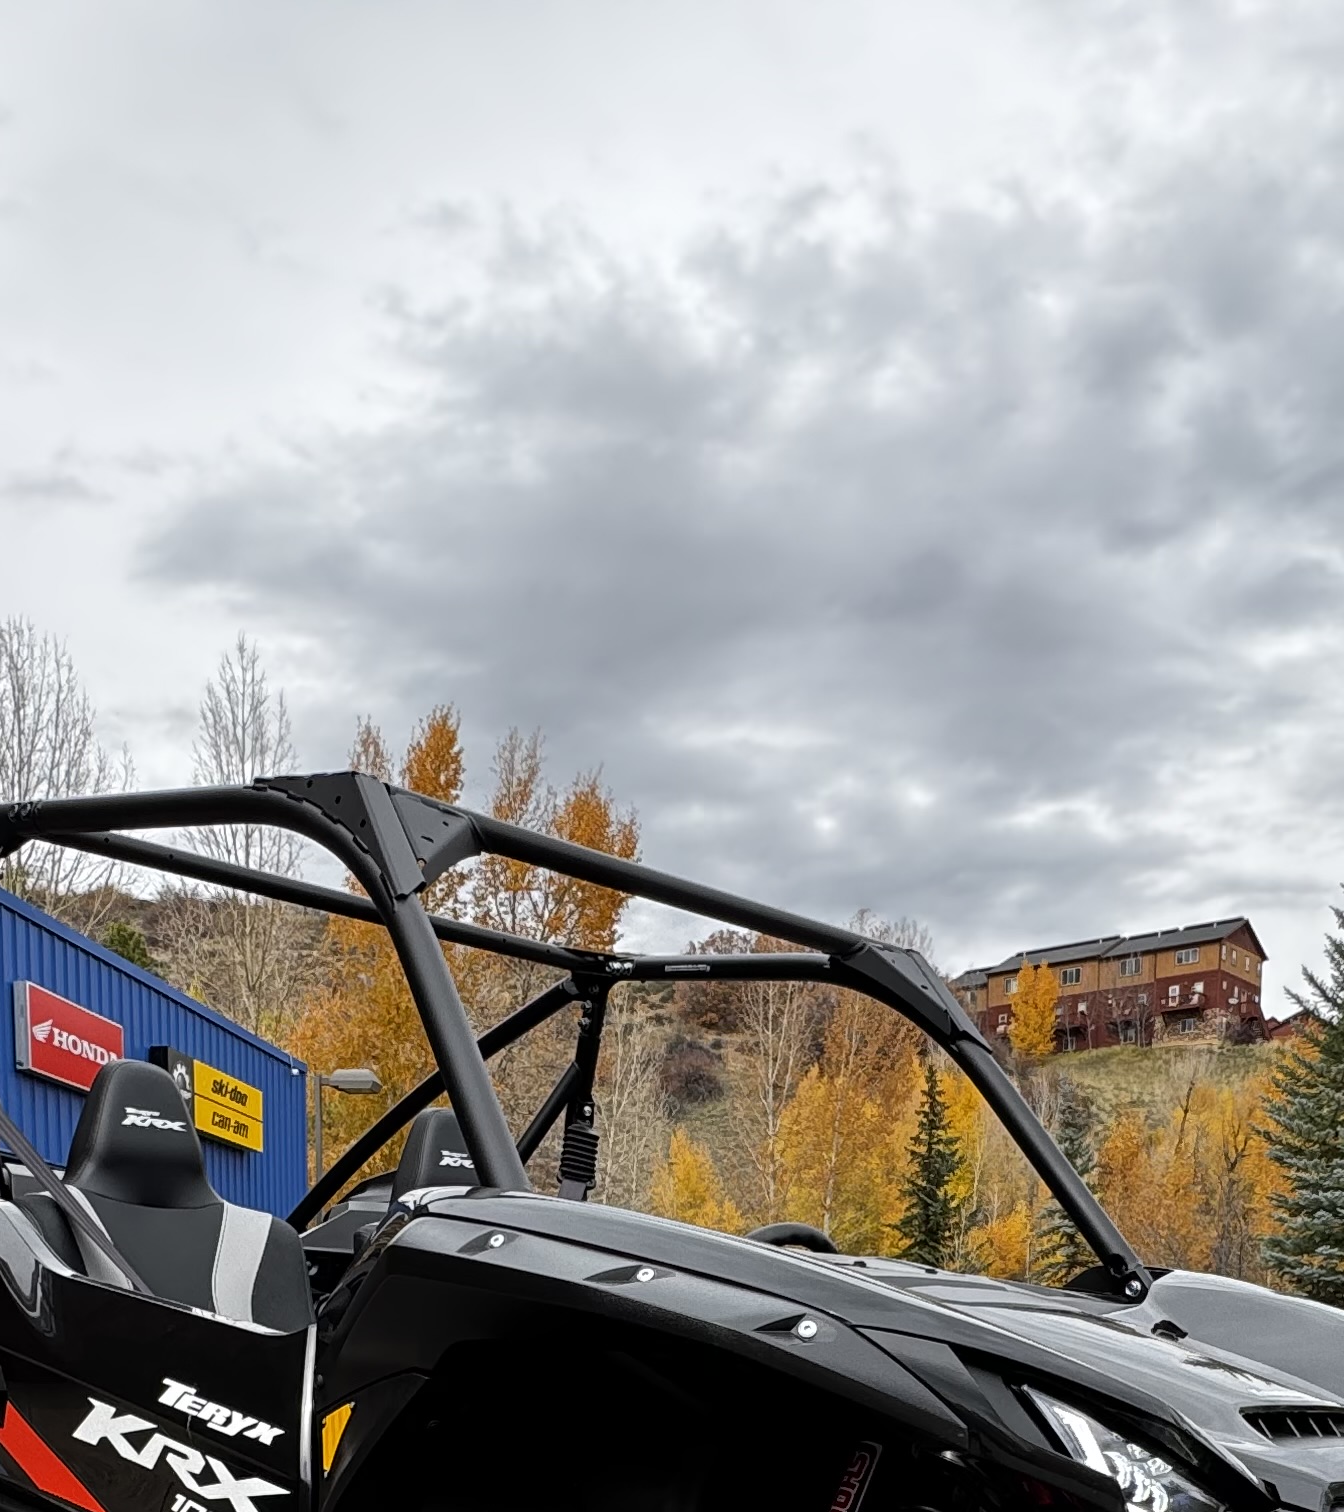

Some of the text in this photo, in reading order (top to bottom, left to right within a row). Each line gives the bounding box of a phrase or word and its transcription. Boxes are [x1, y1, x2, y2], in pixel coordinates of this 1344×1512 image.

[211, 1079, 248, 1106] ski-doo
[211, 1111, 248, 1138] can-am
[439, 1156, 475, 1168] KR
